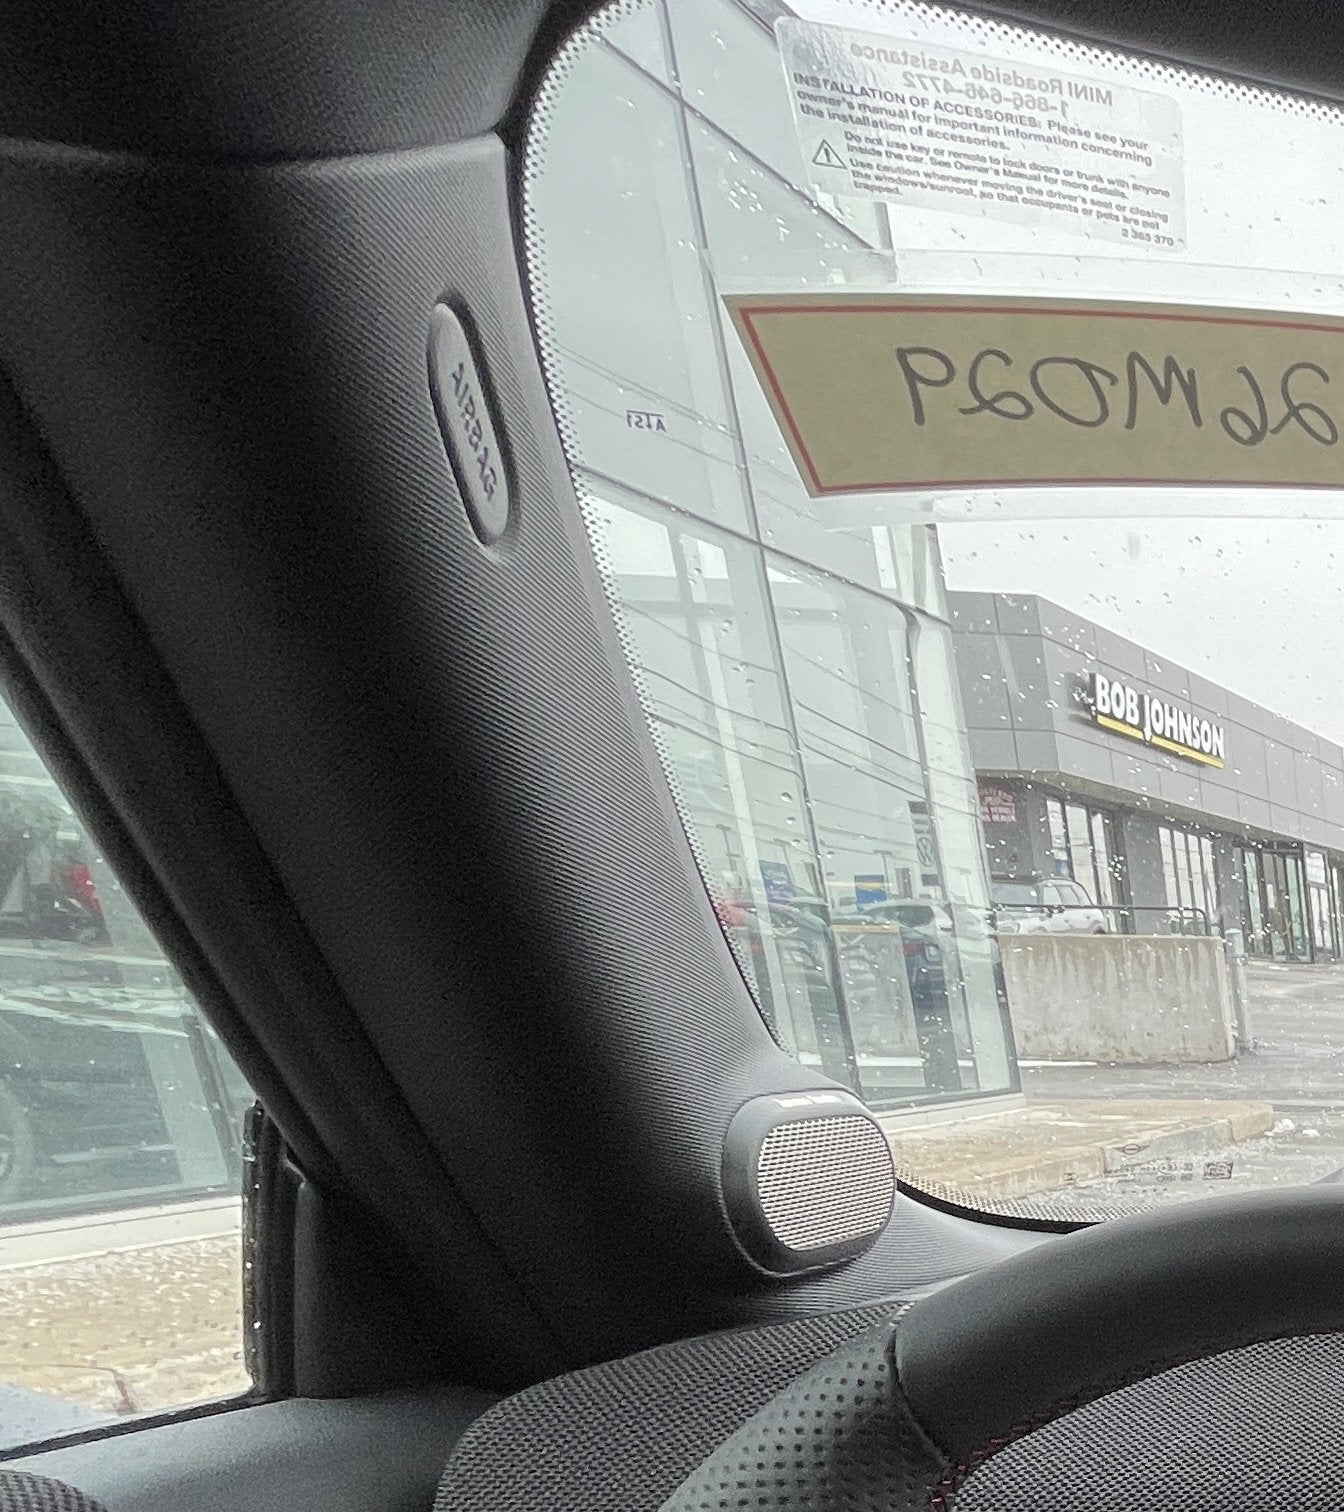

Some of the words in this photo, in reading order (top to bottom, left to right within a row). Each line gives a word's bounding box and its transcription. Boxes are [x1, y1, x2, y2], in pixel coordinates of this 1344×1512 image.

[793, 72, 906, 105] INSTALLATION
[909, 95, 930, 109] OF
[1047, 119, 1091, 138] Please
[1095, 132, 1117, 144] see
[1120, 137, 1149, 150] your
[797, 89, 855, 110] owner's
[858, 102, 910, 120] manual
[912, 110, 931, 124] for
[934, 114, 1000, 136] important
[1003, 125, 1079, 149] information
[1081, 142, 1152, 167] concerning
[800, 103, 825, 118] the
[828, 107, 906, 133] installation
[909, 124, 924, 137] of
[844, 130, 861, 143] Do
[865, 134, 884, 147] not
[887, 140, 908, 151] use
[911, 142, 930, 156] key
[933, 147, 945, 156] or
[947, 149, 987, 164] remote
[989, 153, 1001, 165] to
[1029, 161, 1061, 175] doors
[1062, 168, 1074, 177] or
[1107, 176, 1129, 189] with
[1132, 183, 1171, 198] anyone
[849, 157, 874, 170] Use
[876, 163, 920, 177] caution
[923, 170, 978, 187] whenever
[981, 180, 1024, 195] moving
[1025, 186, 1044, 197] the
[1115, 203, 1127, 213] or
[1129, 206, 1169, 223] closing
[851, 169, 872, 181] the
[1081, 207, 1093, 217] or
[885, 149, 904, 161] the
[930, 156, 951, 168] See
[1043, 174, 1059, 185] for
[1061, 179, 1090, 192] more
[449, 362, 498, 502] AIRBAG
[1095, 673, 1140, 726] BOB
[1143, 693, 1226, 760] JOHNSON
